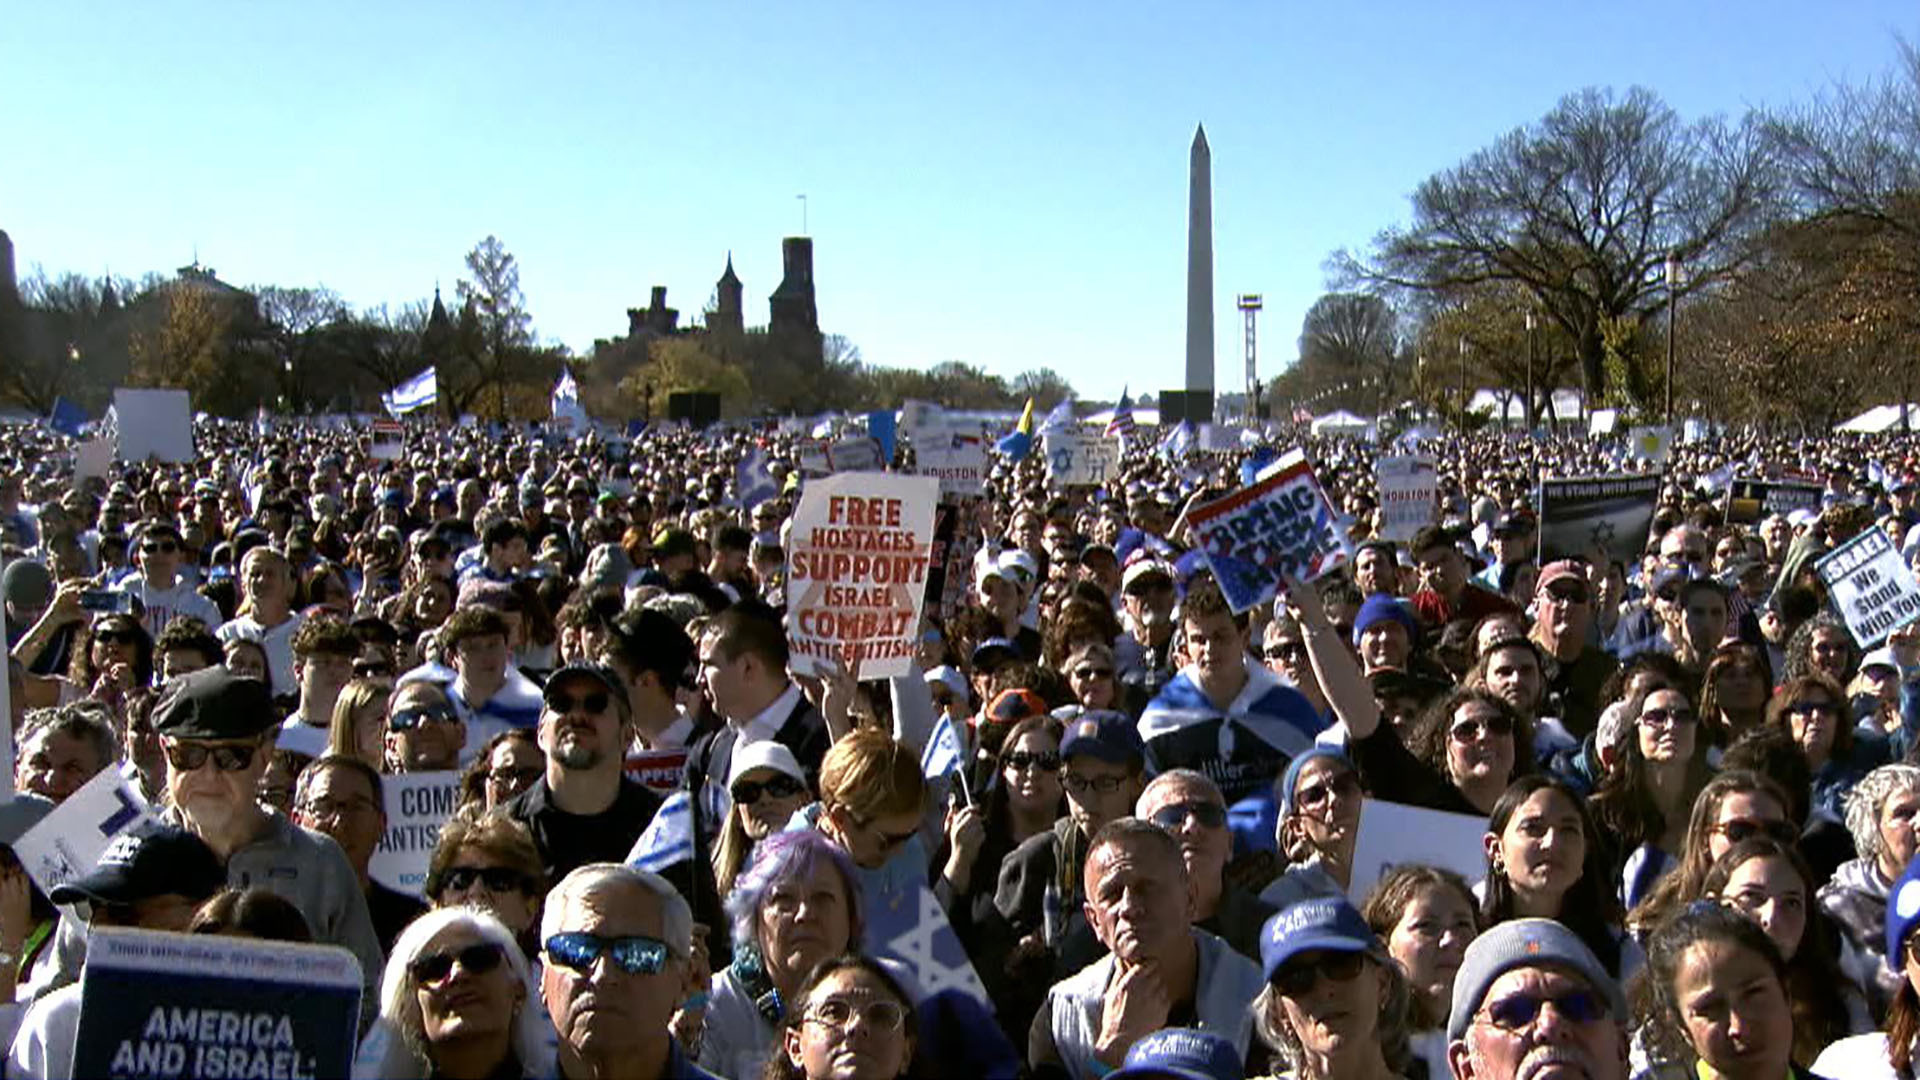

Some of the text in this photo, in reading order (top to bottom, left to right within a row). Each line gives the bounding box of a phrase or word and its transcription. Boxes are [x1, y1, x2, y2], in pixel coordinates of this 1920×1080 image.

[922, 466, 978, 480] HOUSTON
[1384, 489, 1431, 501] HOUSTON
[829, 496, 902, 526] FREE
[1211, 485, 1315, 558] BRING
[811, 528, 915, 551] HOSTAGES
[791, 552, 928, 584] SUPPORT
[1852, 568, 1880, 592] We
[825, 584, 894, 606] ISRAEL
[1854, 578, 1902, 616] Stand
[800, 608, 913, 640] COMBAT
[1855, 589, 1920, 640] With You
[379, 823, 440, 853] ANTIS
[144, 1005, 293, 1048] AMERICA
[110, 1040, 317, 1080] AND ISRAEL:
